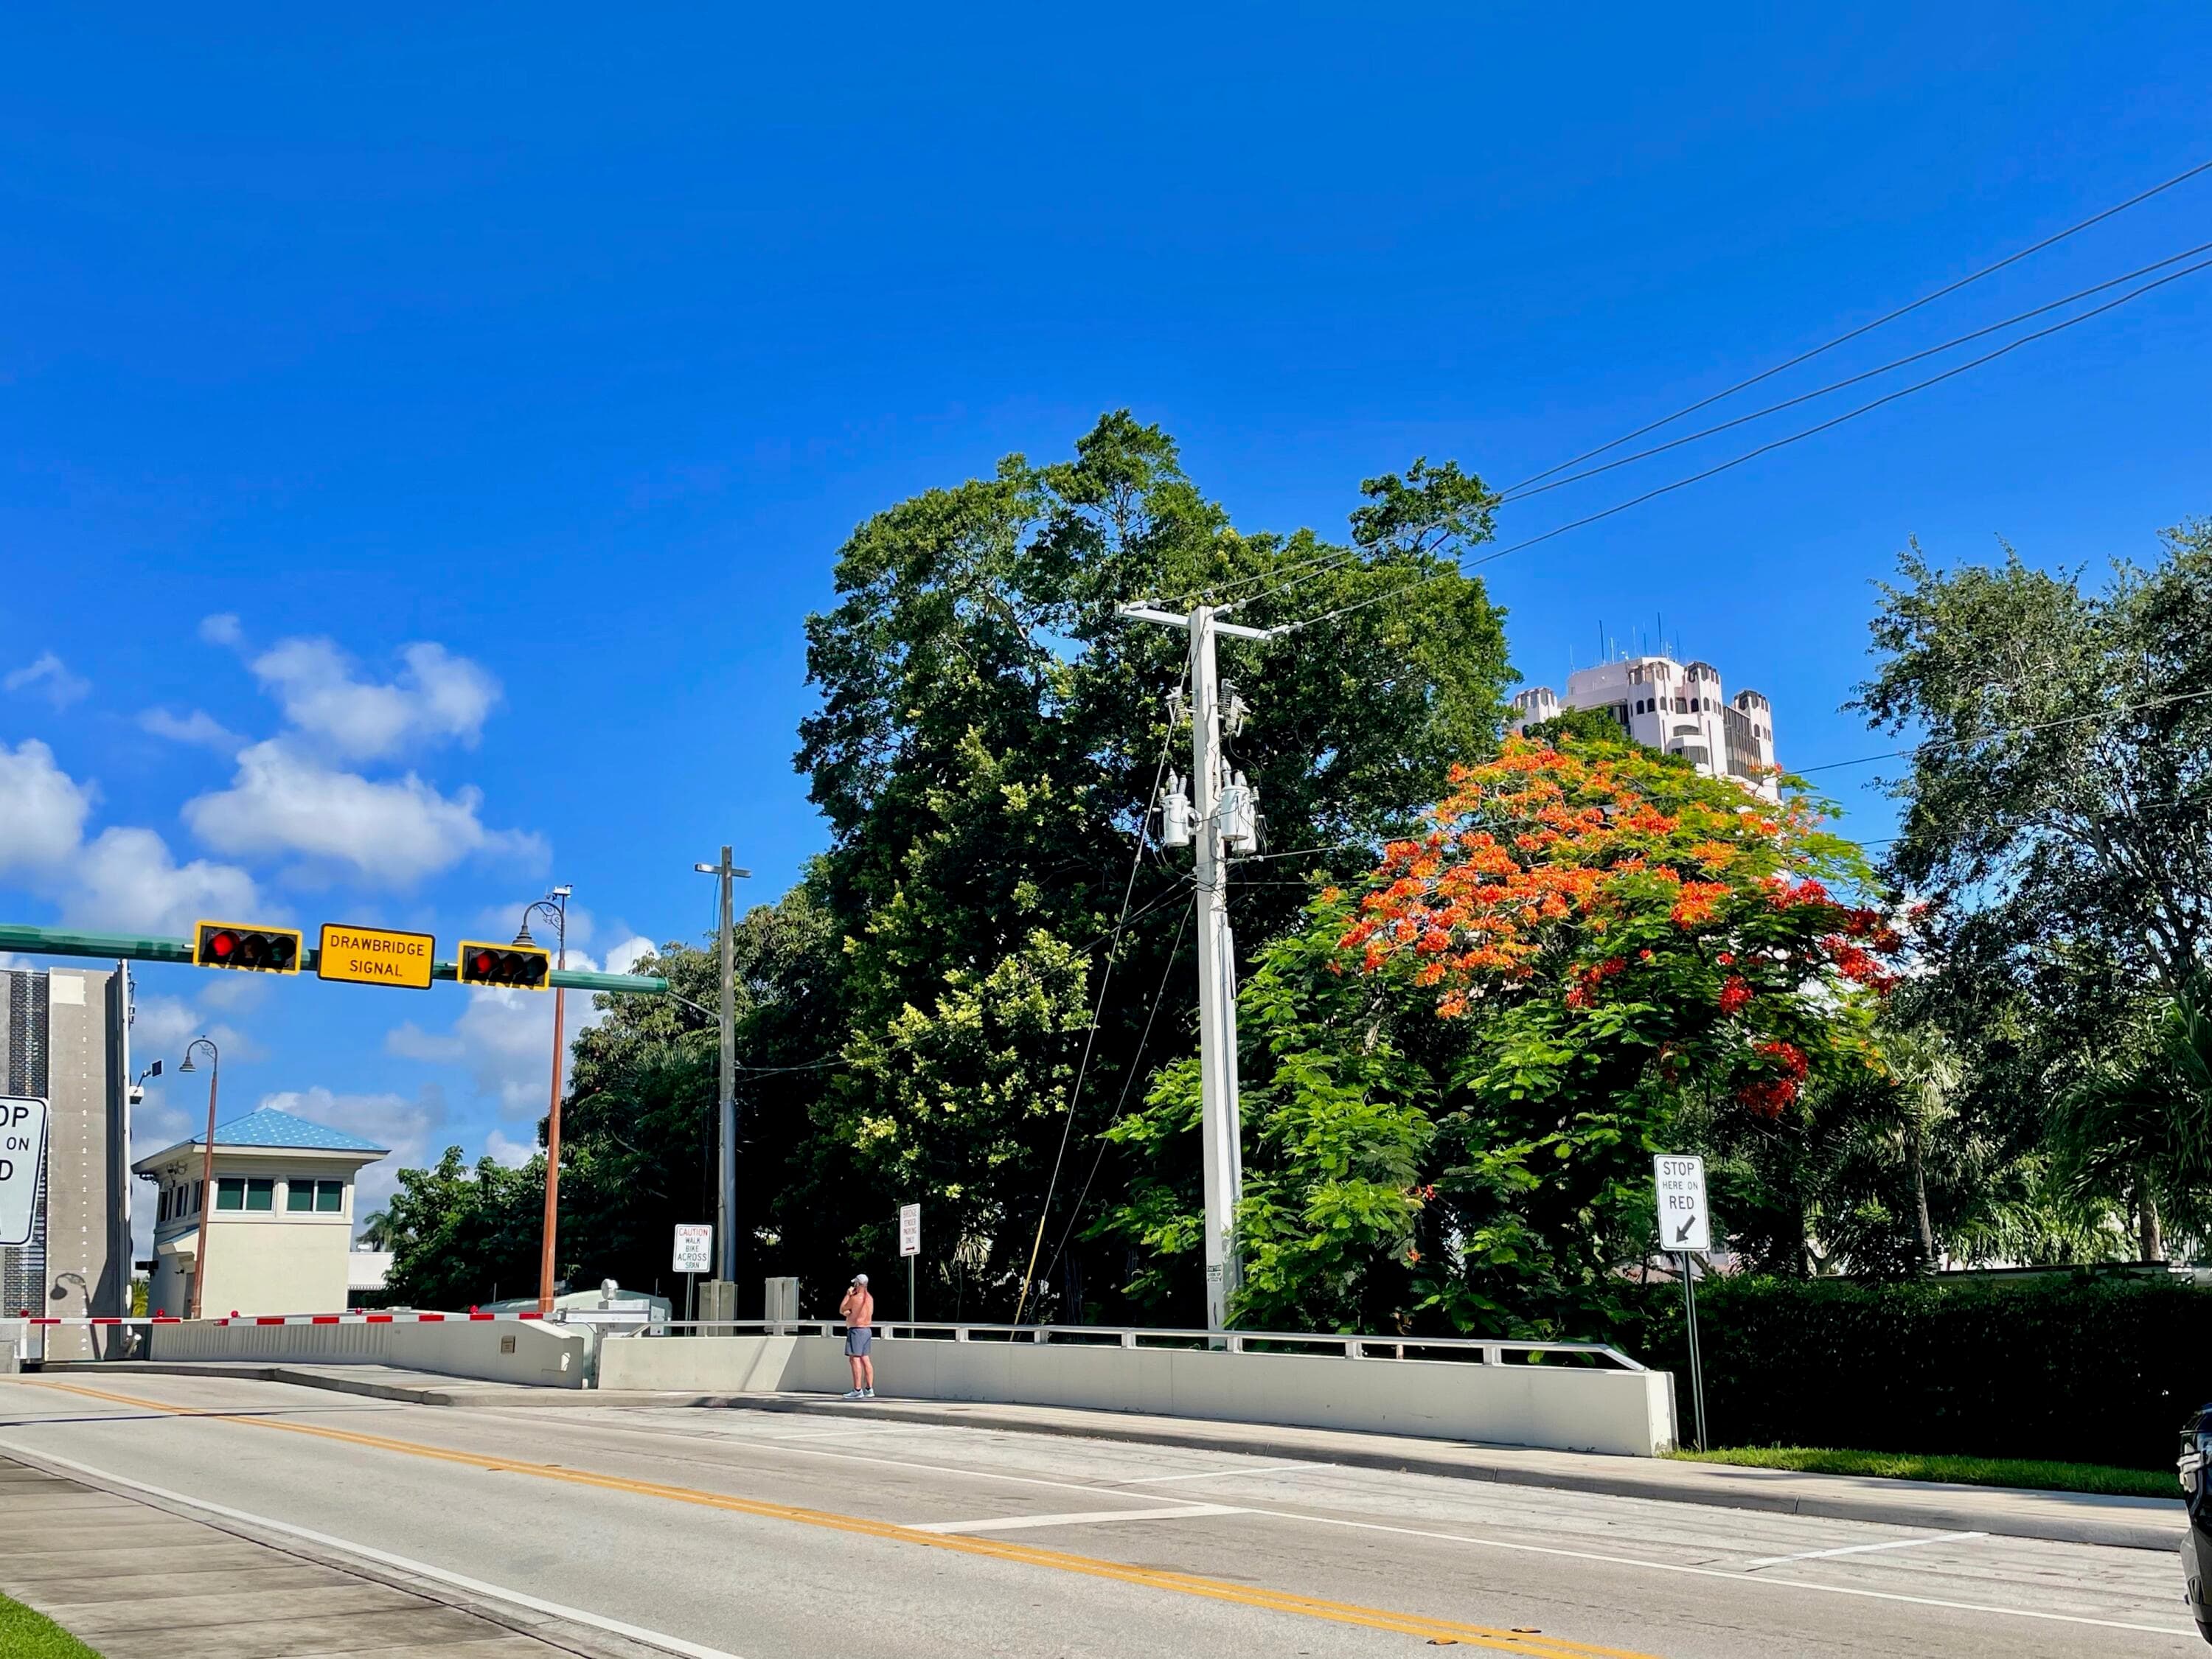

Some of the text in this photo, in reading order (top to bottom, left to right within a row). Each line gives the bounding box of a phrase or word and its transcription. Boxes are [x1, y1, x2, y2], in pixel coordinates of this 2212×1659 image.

[330, 935, 425, 956] DRAWBRIDGE
[349, 960, 403, 977] SIGNAL
[7, 1136, 29, 1151] ON
[1663, 1161, 1694, 1176] STOP
[1663, 1180, 1699, 1190] HERE ON
[1669, 1195, 1694, 1210] RED
[679, 1228, 708, 1237] CAUTION
[678, 1253, 707, 1262] ACROSS
